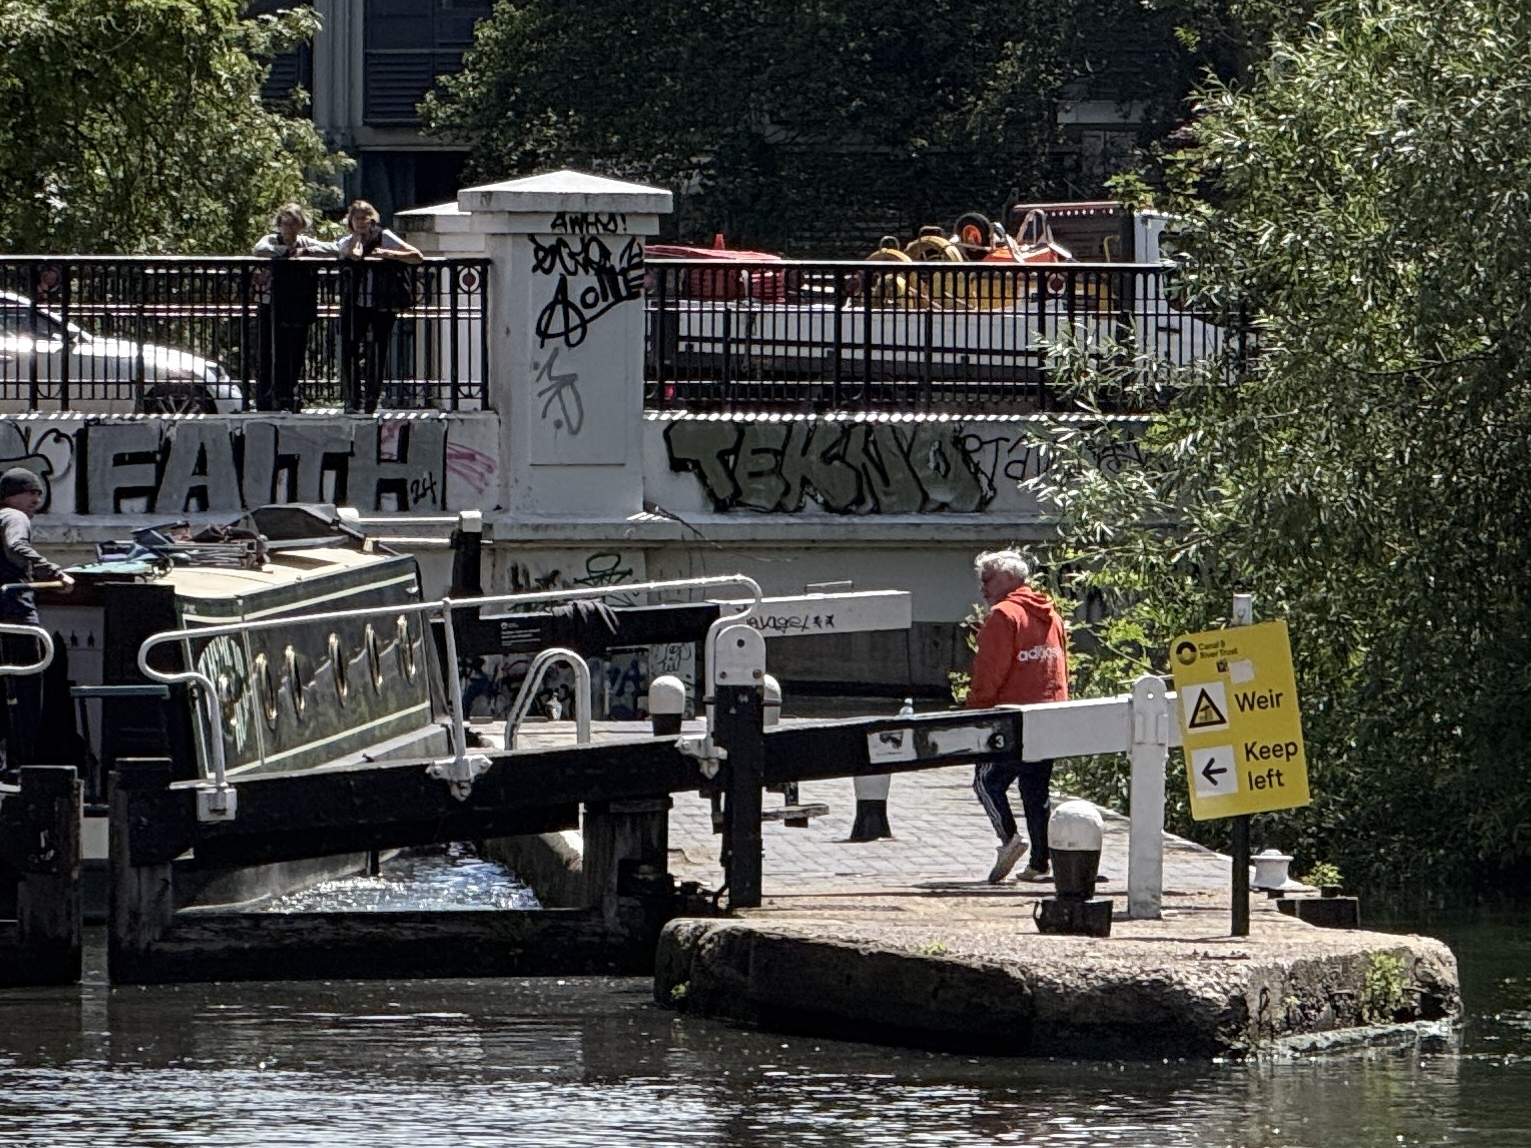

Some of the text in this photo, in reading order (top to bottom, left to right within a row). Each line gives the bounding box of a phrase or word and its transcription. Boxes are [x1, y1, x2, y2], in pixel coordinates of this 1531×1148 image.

[73, 418, 448, 515] FAITH
[1234, 689, 1284, 712] Weir
[1244, 740, 1298, 762] Keep
[1248, 768, 1285, 790] left
